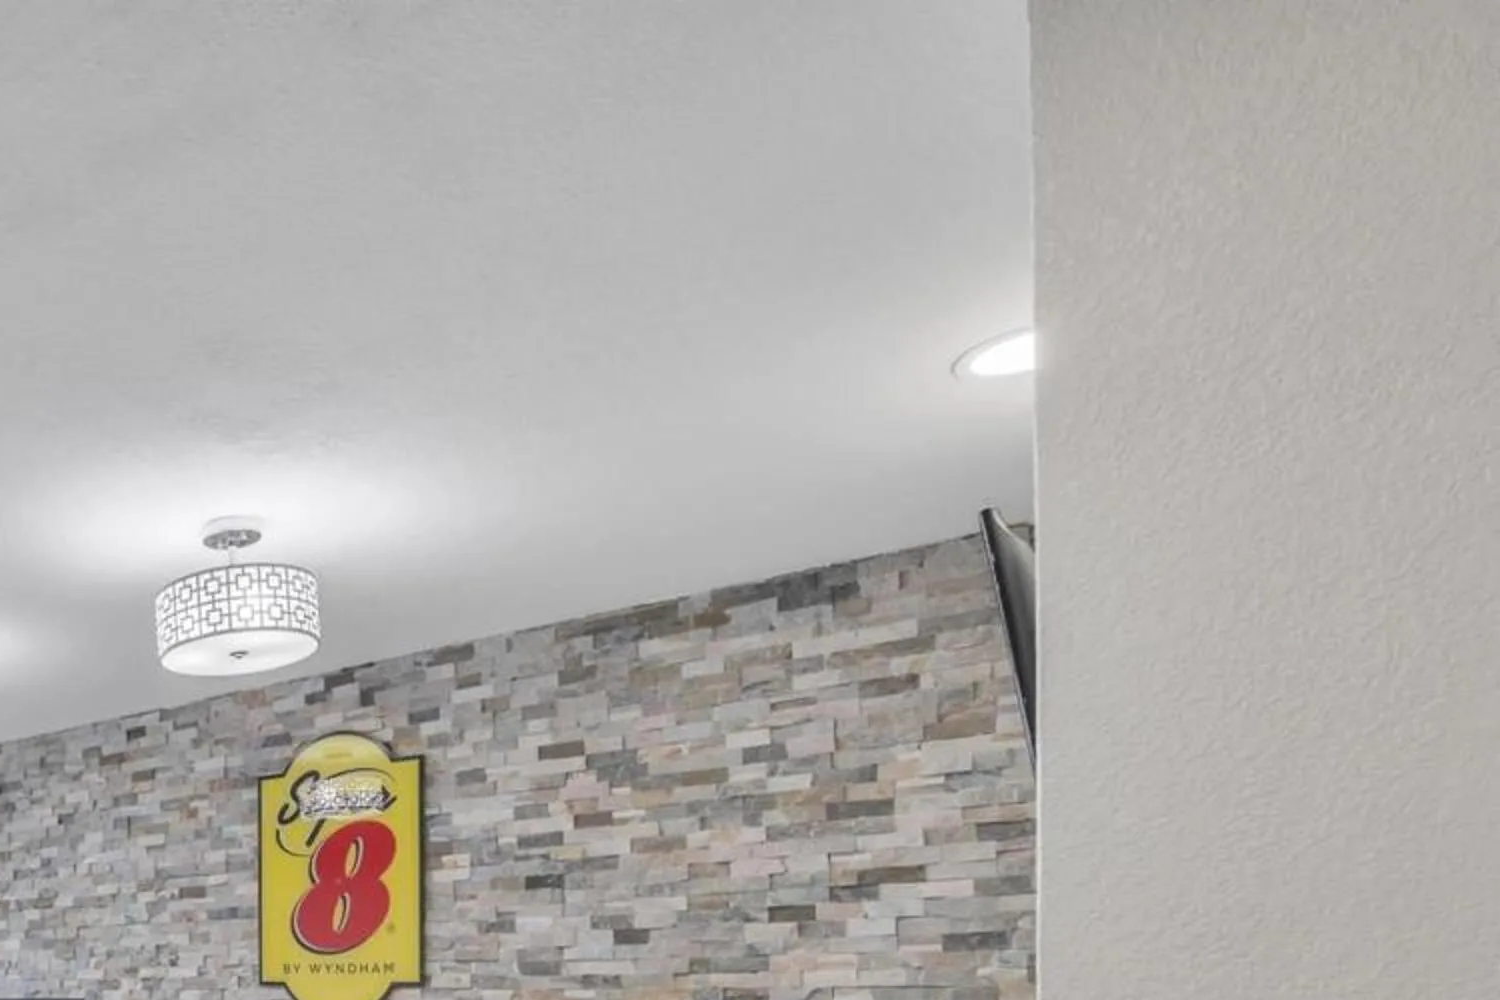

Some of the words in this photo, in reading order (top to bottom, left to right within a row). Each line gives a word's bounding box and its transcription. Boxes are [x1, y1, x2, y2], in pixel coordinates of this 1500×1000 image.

[289, 819, 397, 954] 8
[283, 962, 301, 976] BY
[308, 960, 396, 977] WYNDHAM
